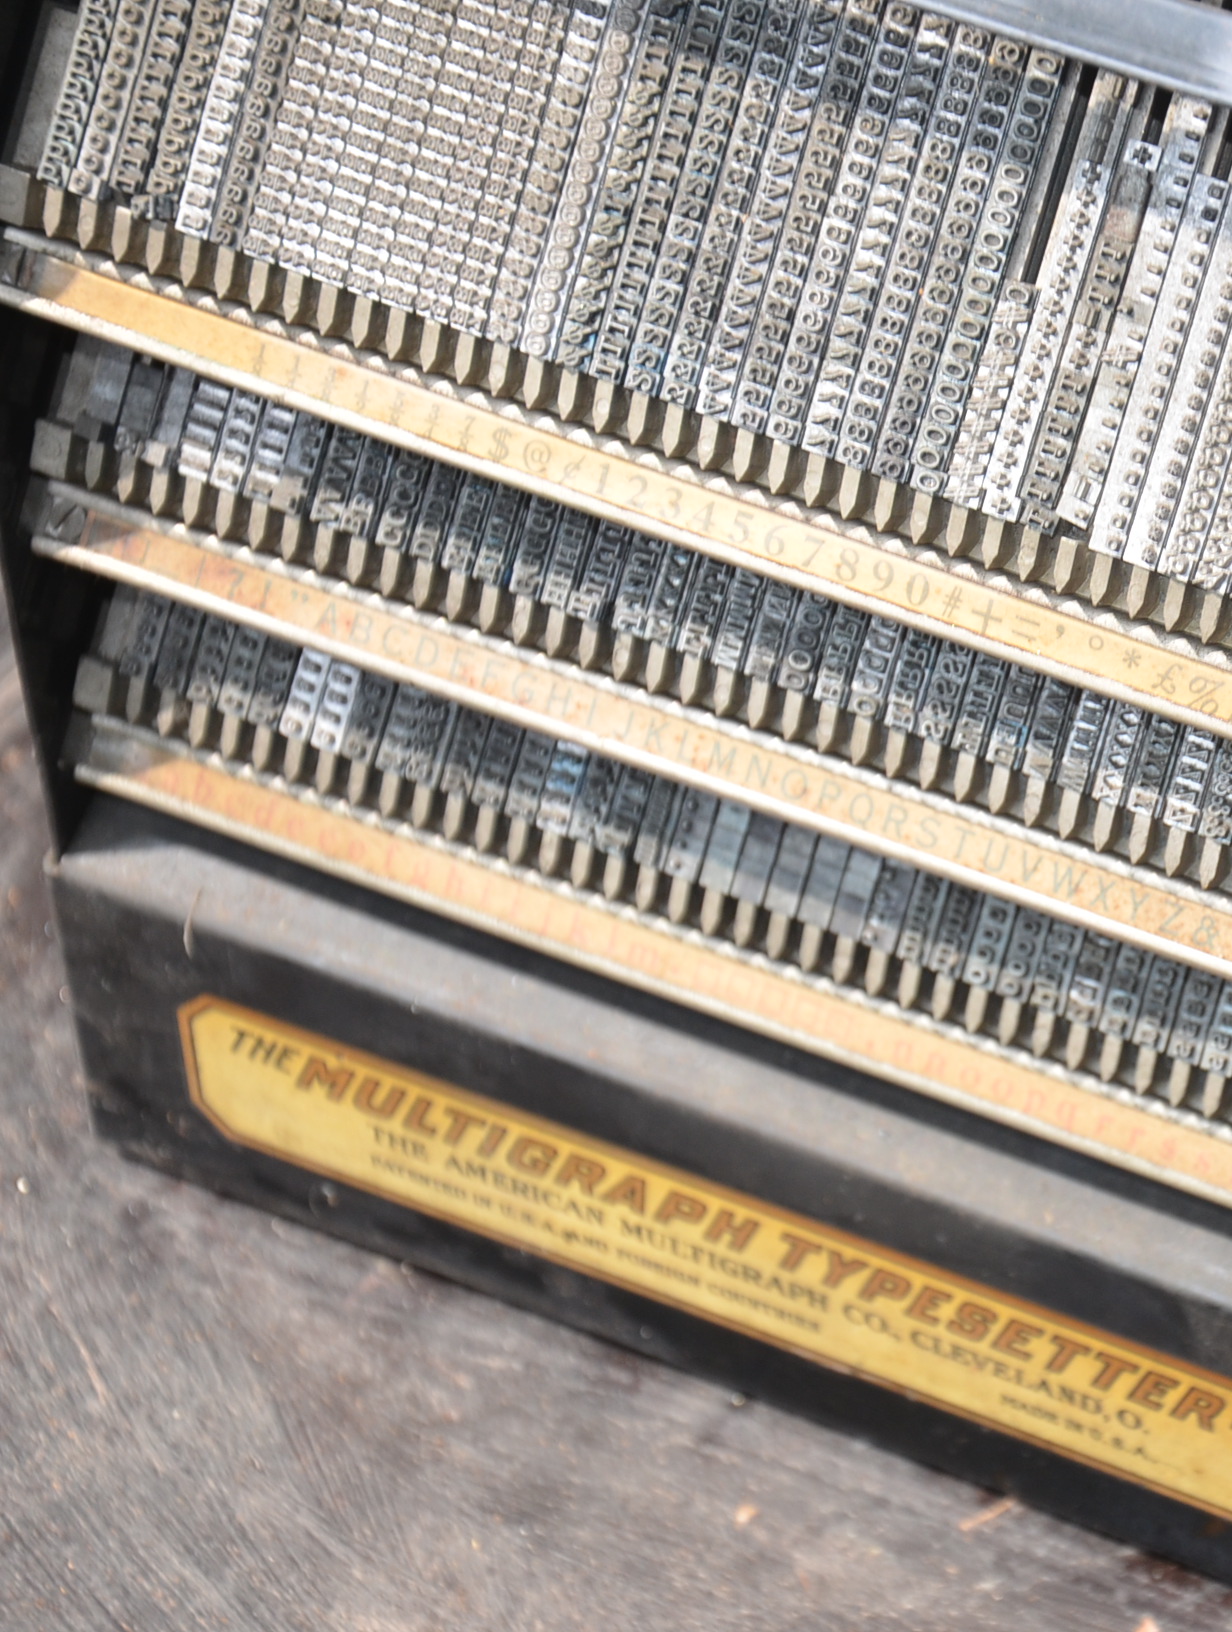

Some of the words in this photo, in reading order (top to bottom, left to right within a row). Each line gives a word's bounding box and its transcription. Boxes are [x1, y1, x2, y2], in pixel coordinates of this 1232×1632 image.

[230, 1027, 292, 1074] THE
[295, 1055, 760, 1253] MULTIGRAPH
[780, 1232, 1226, 1433] TYPESETTER
[371, 1125, 430, 1163] THE
[445, 1154, 606, 1226] AMERICAN
[619, 1218, 831, 1312] MULTIGRAPH
